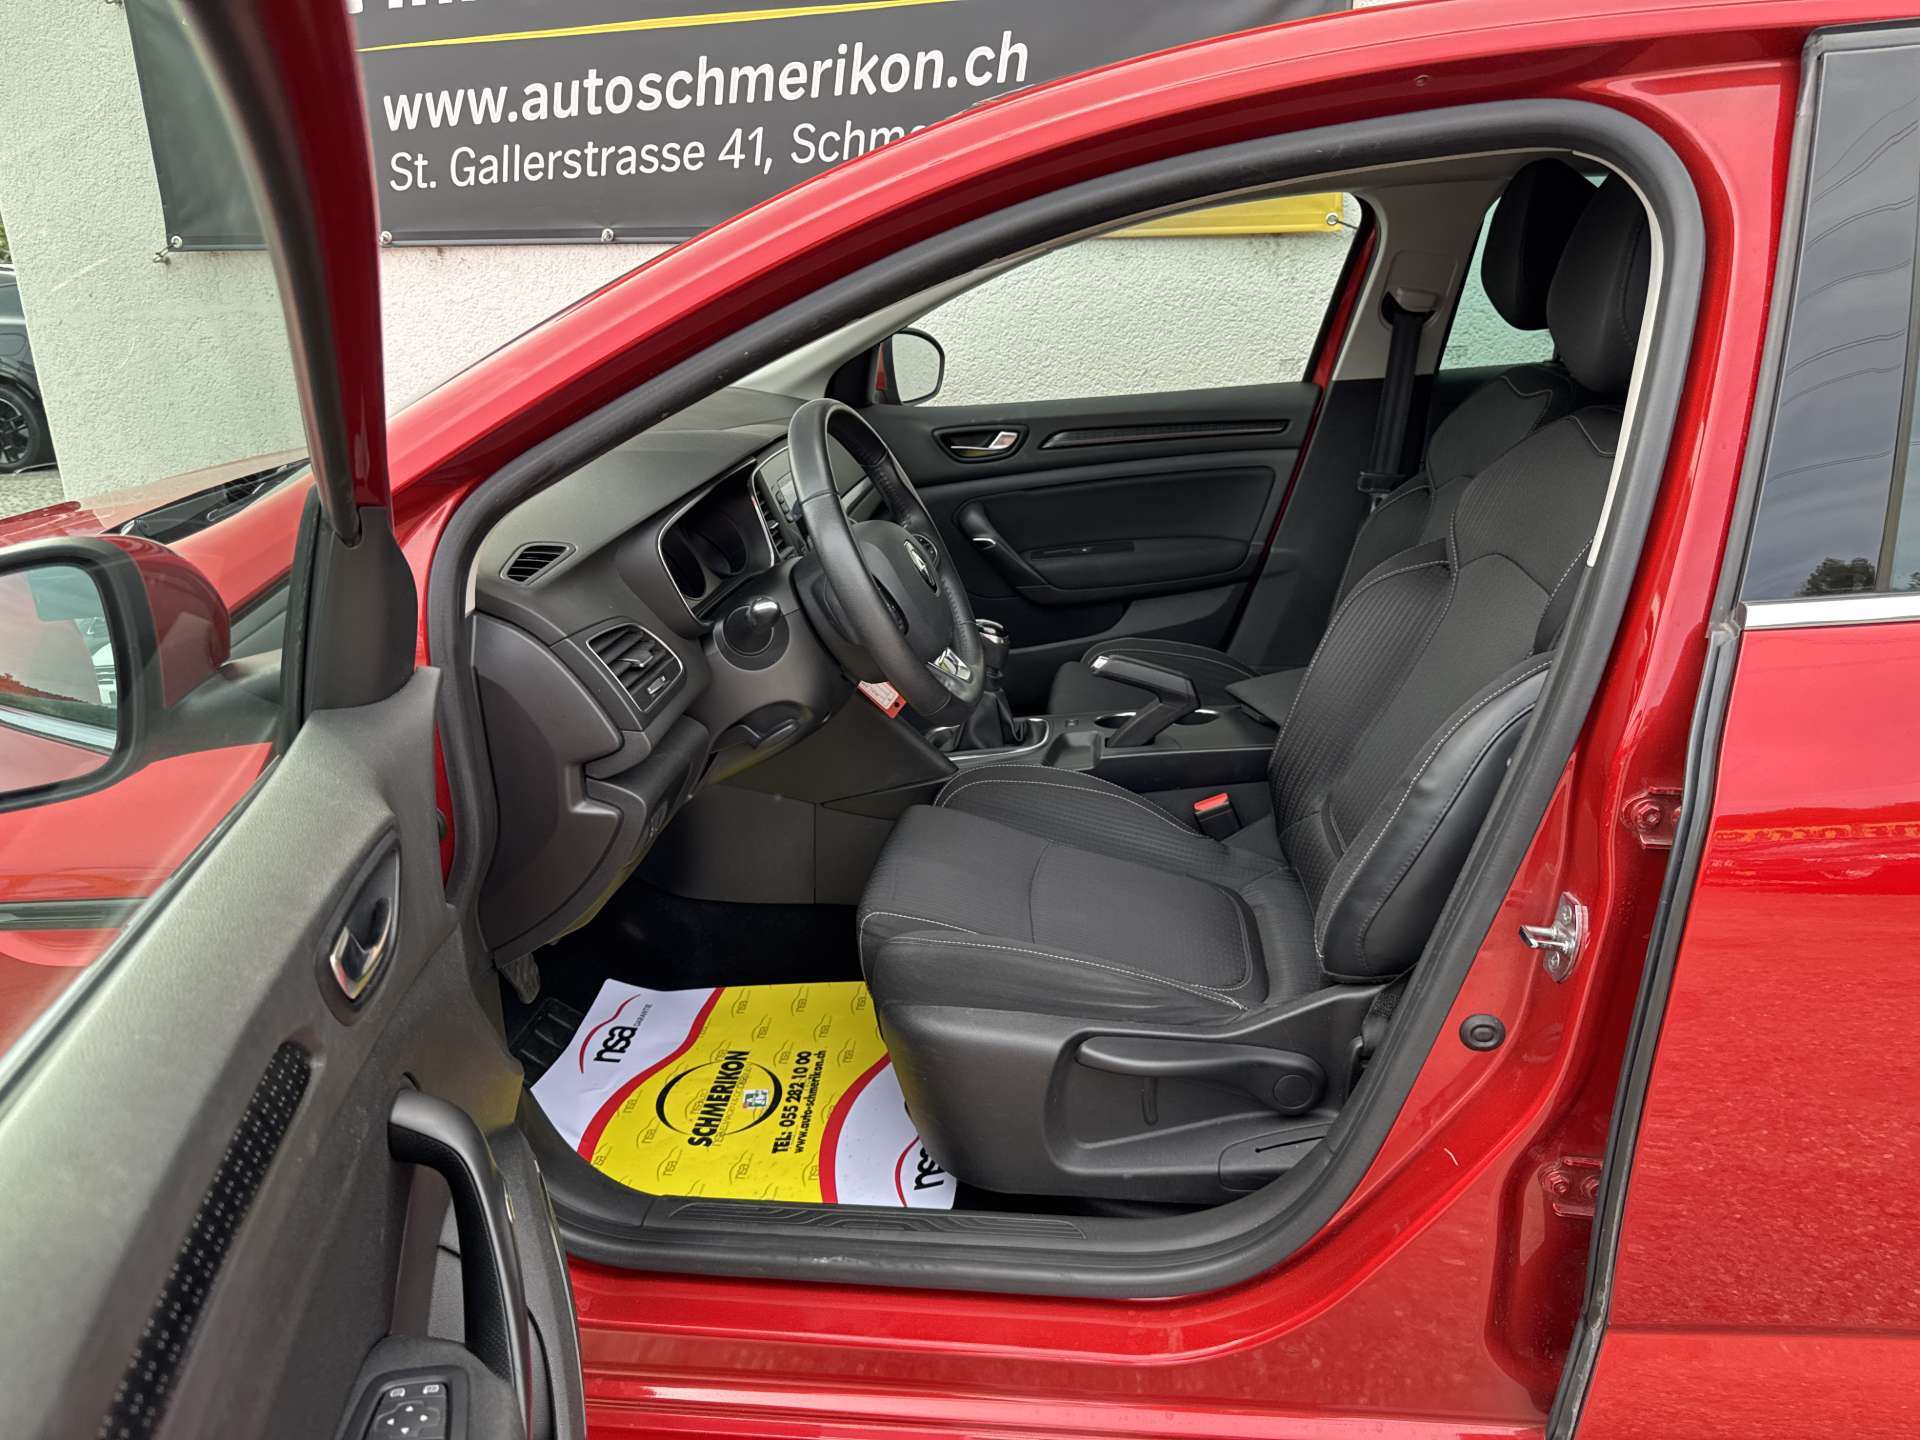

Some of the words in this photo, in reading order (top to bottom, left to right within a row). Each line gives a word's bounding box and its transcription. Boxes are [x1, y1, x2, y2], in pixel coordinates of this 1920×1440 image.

[383, 30, 1029, 131] www.autoschmerikon.ch
[389, 152, 437, 191] St.
[450, 139, 706, 188] Gallerstrasse
[718, 126, 772, 175] 41,
[790, 120, 926, 164] Schm
[593, 1026, 638, 1063] nsa
[795, 1051, 812, 1065] 00
[792, 1067, 809, 1080] 10
[687, 1051, 750, 1147] SCHMERIKON
[788, 1082, 805, 1103] 282
[779, 1105, 799, 1128] 055
[771, 1131, 793, 1154] TEL:
